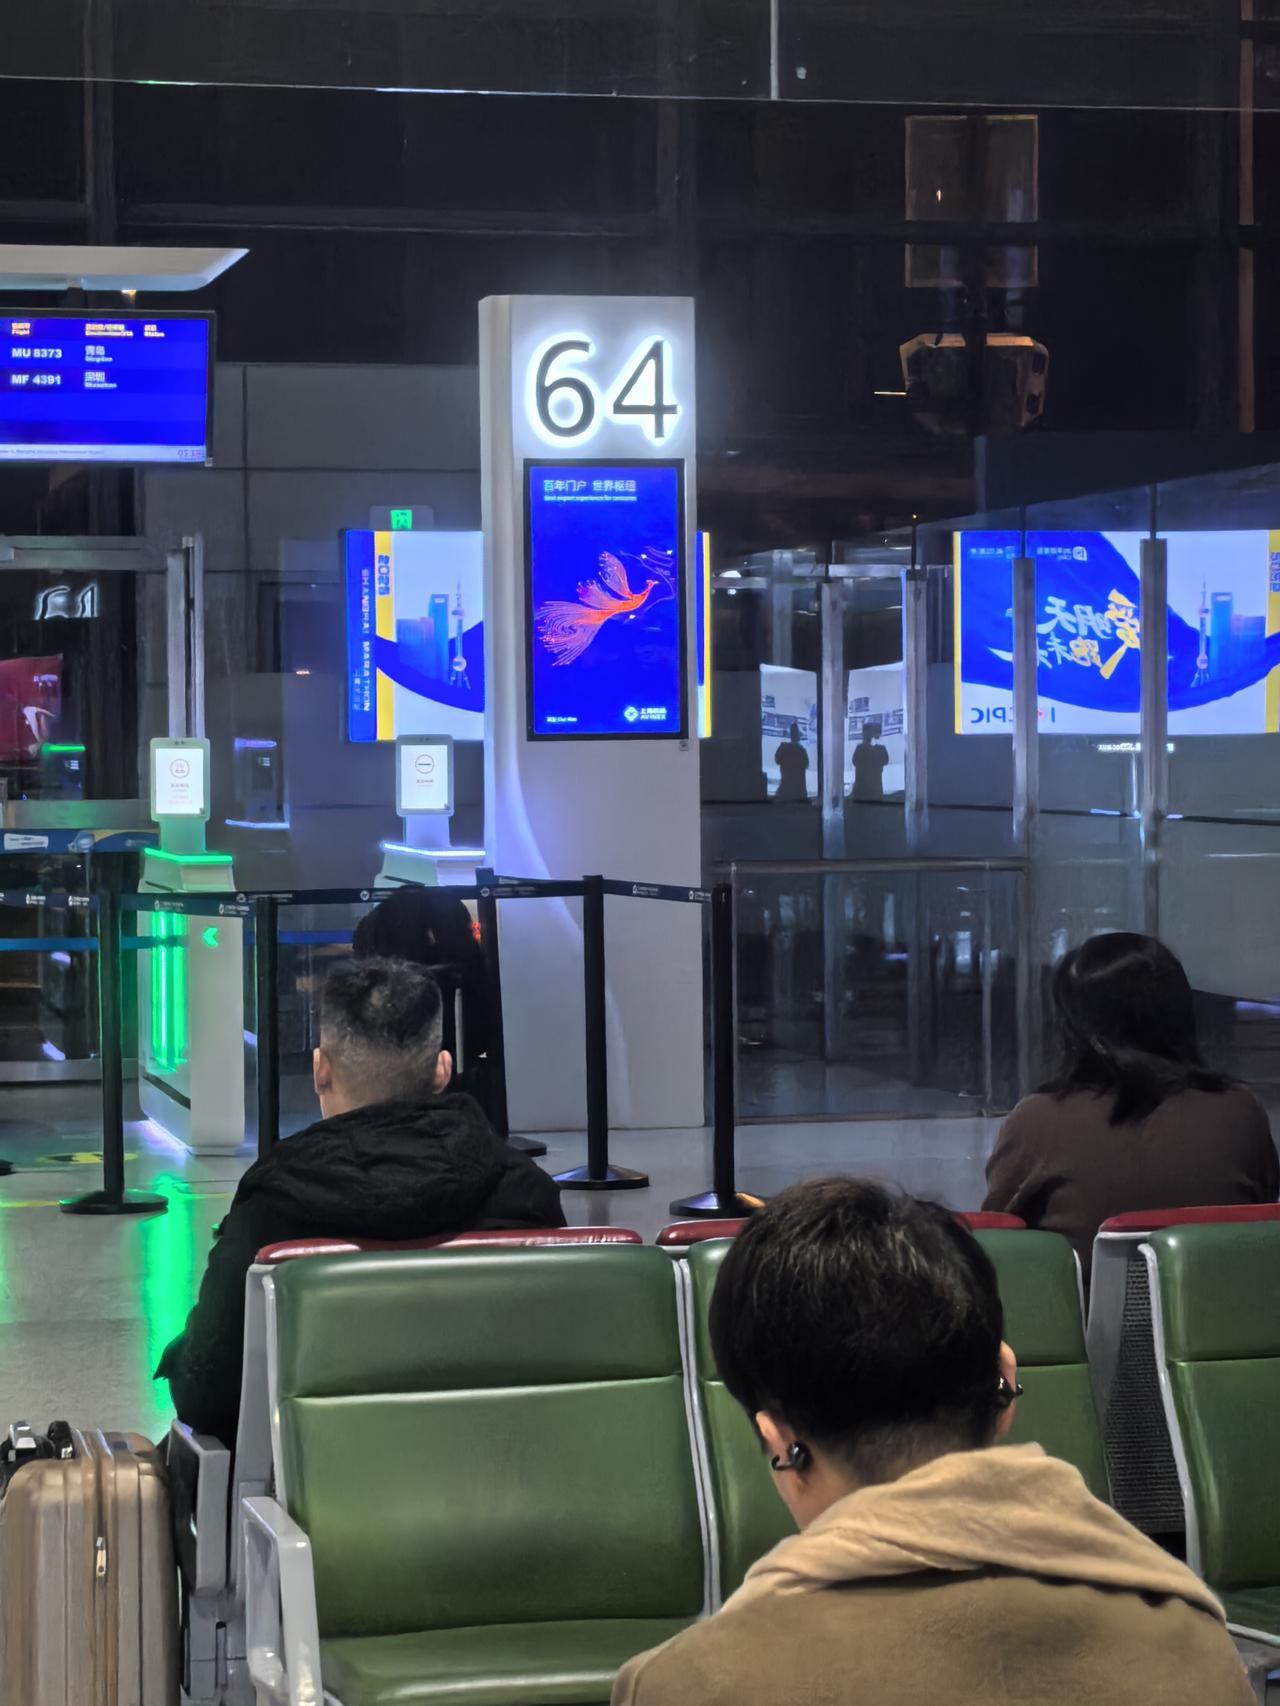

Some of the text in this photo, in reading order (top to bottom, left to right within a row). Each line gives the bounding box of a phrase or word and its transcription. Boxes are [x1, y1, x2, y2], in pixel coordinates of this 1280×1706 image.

[11, 348, 62, 359] MU 8373
[11, 375, 29, 385] MF
[535, 339, 678, 438] 64
[543, 480, 587, 492] 百年门户
[362, 641, 370, 712] MARATHON
